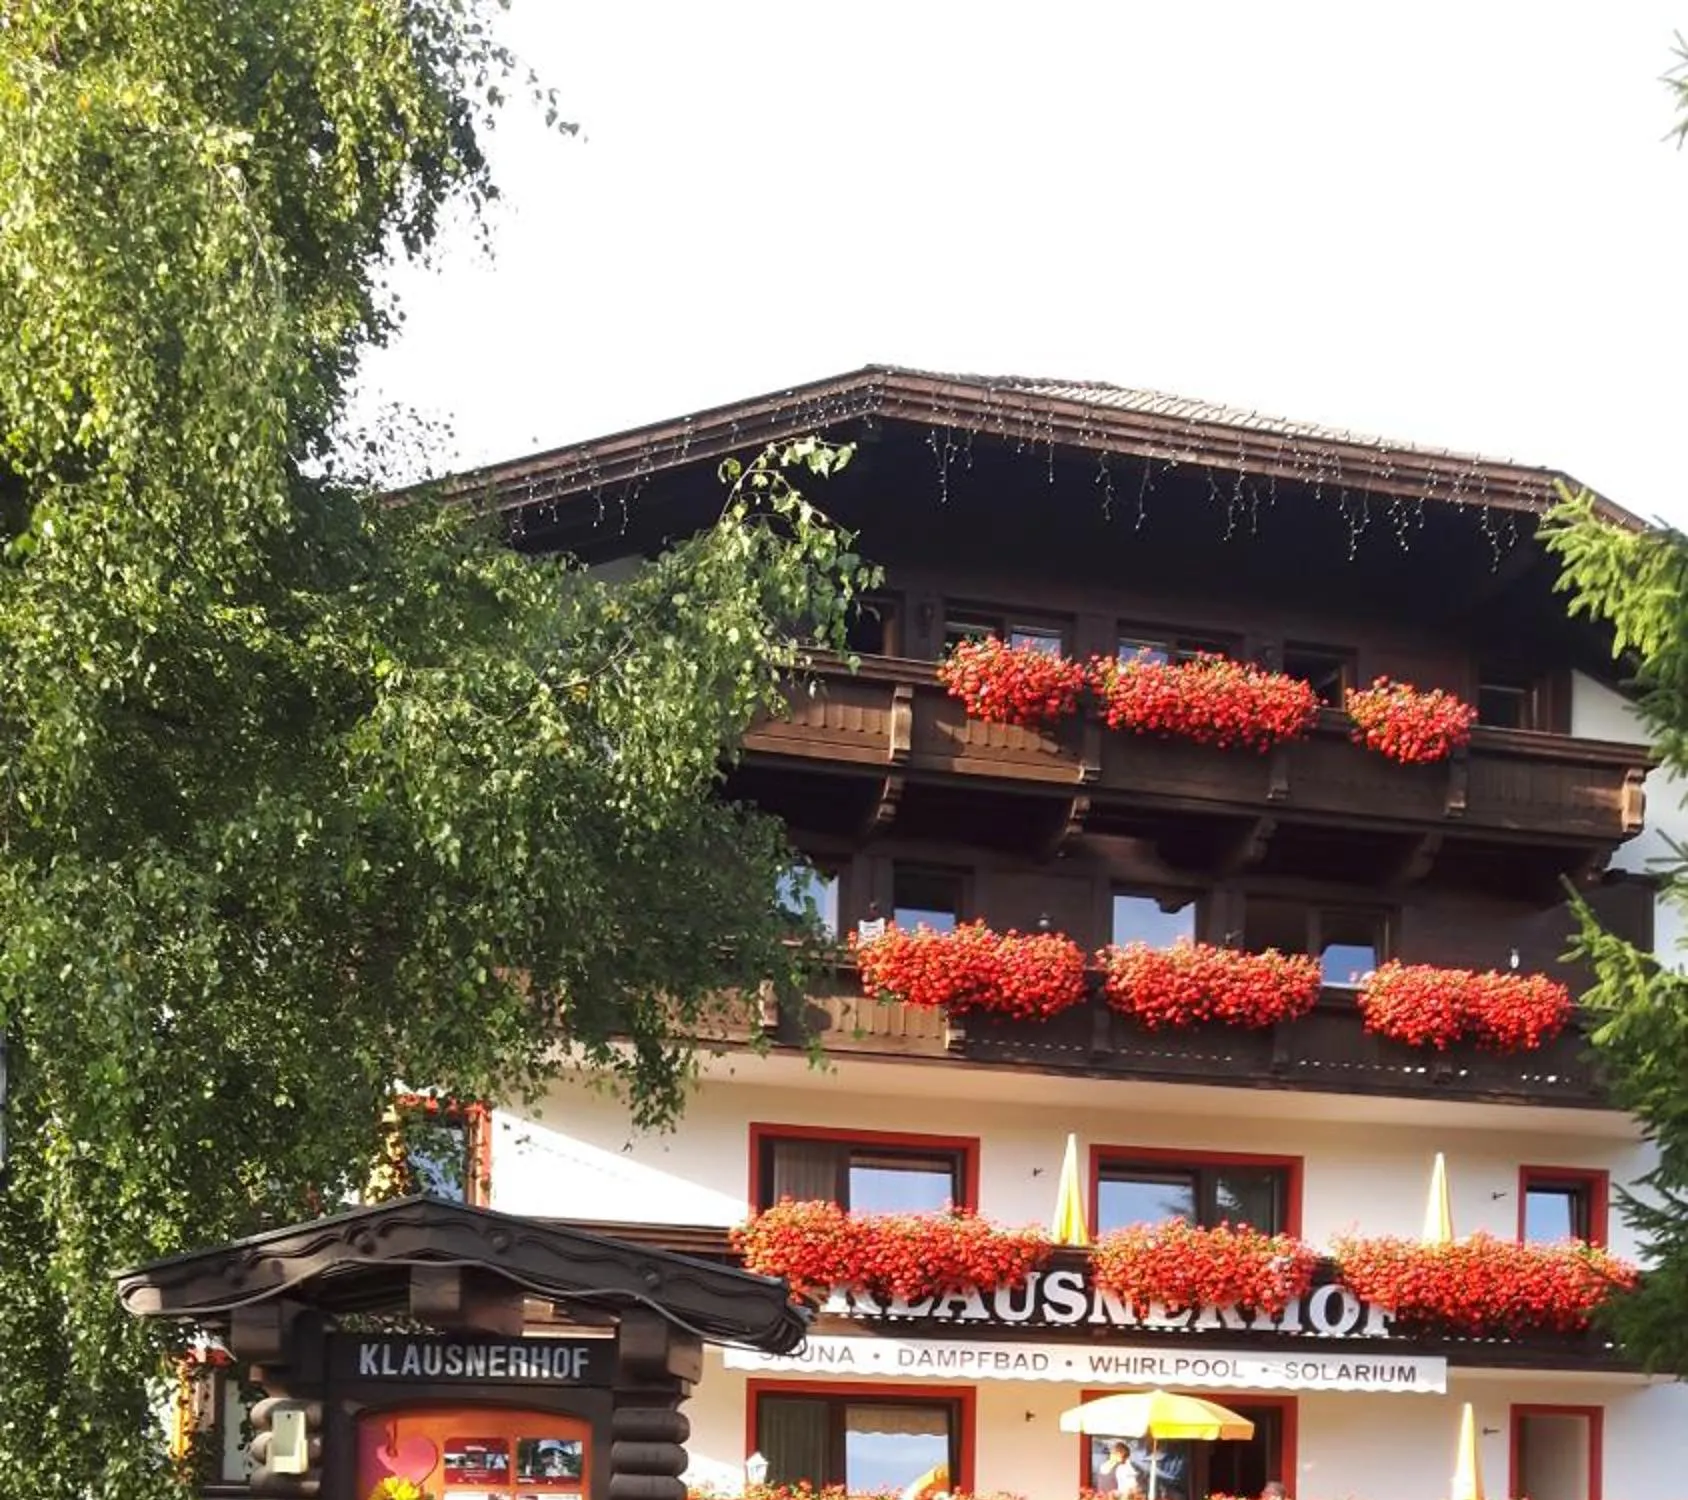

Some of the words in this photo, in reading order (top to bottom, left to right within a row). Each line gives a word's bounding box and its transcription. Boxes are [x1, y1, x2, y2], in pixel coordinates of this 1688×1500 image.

[359, 1343, 590, 1378] KLAUSNERHOF
[898, 1347, 1050, 1371] DAMPFBAD
[1089, 1355, 1245, 1379] WHIRLPOOL
[1284, 1361, 1417, 1383] SOLARIUM
